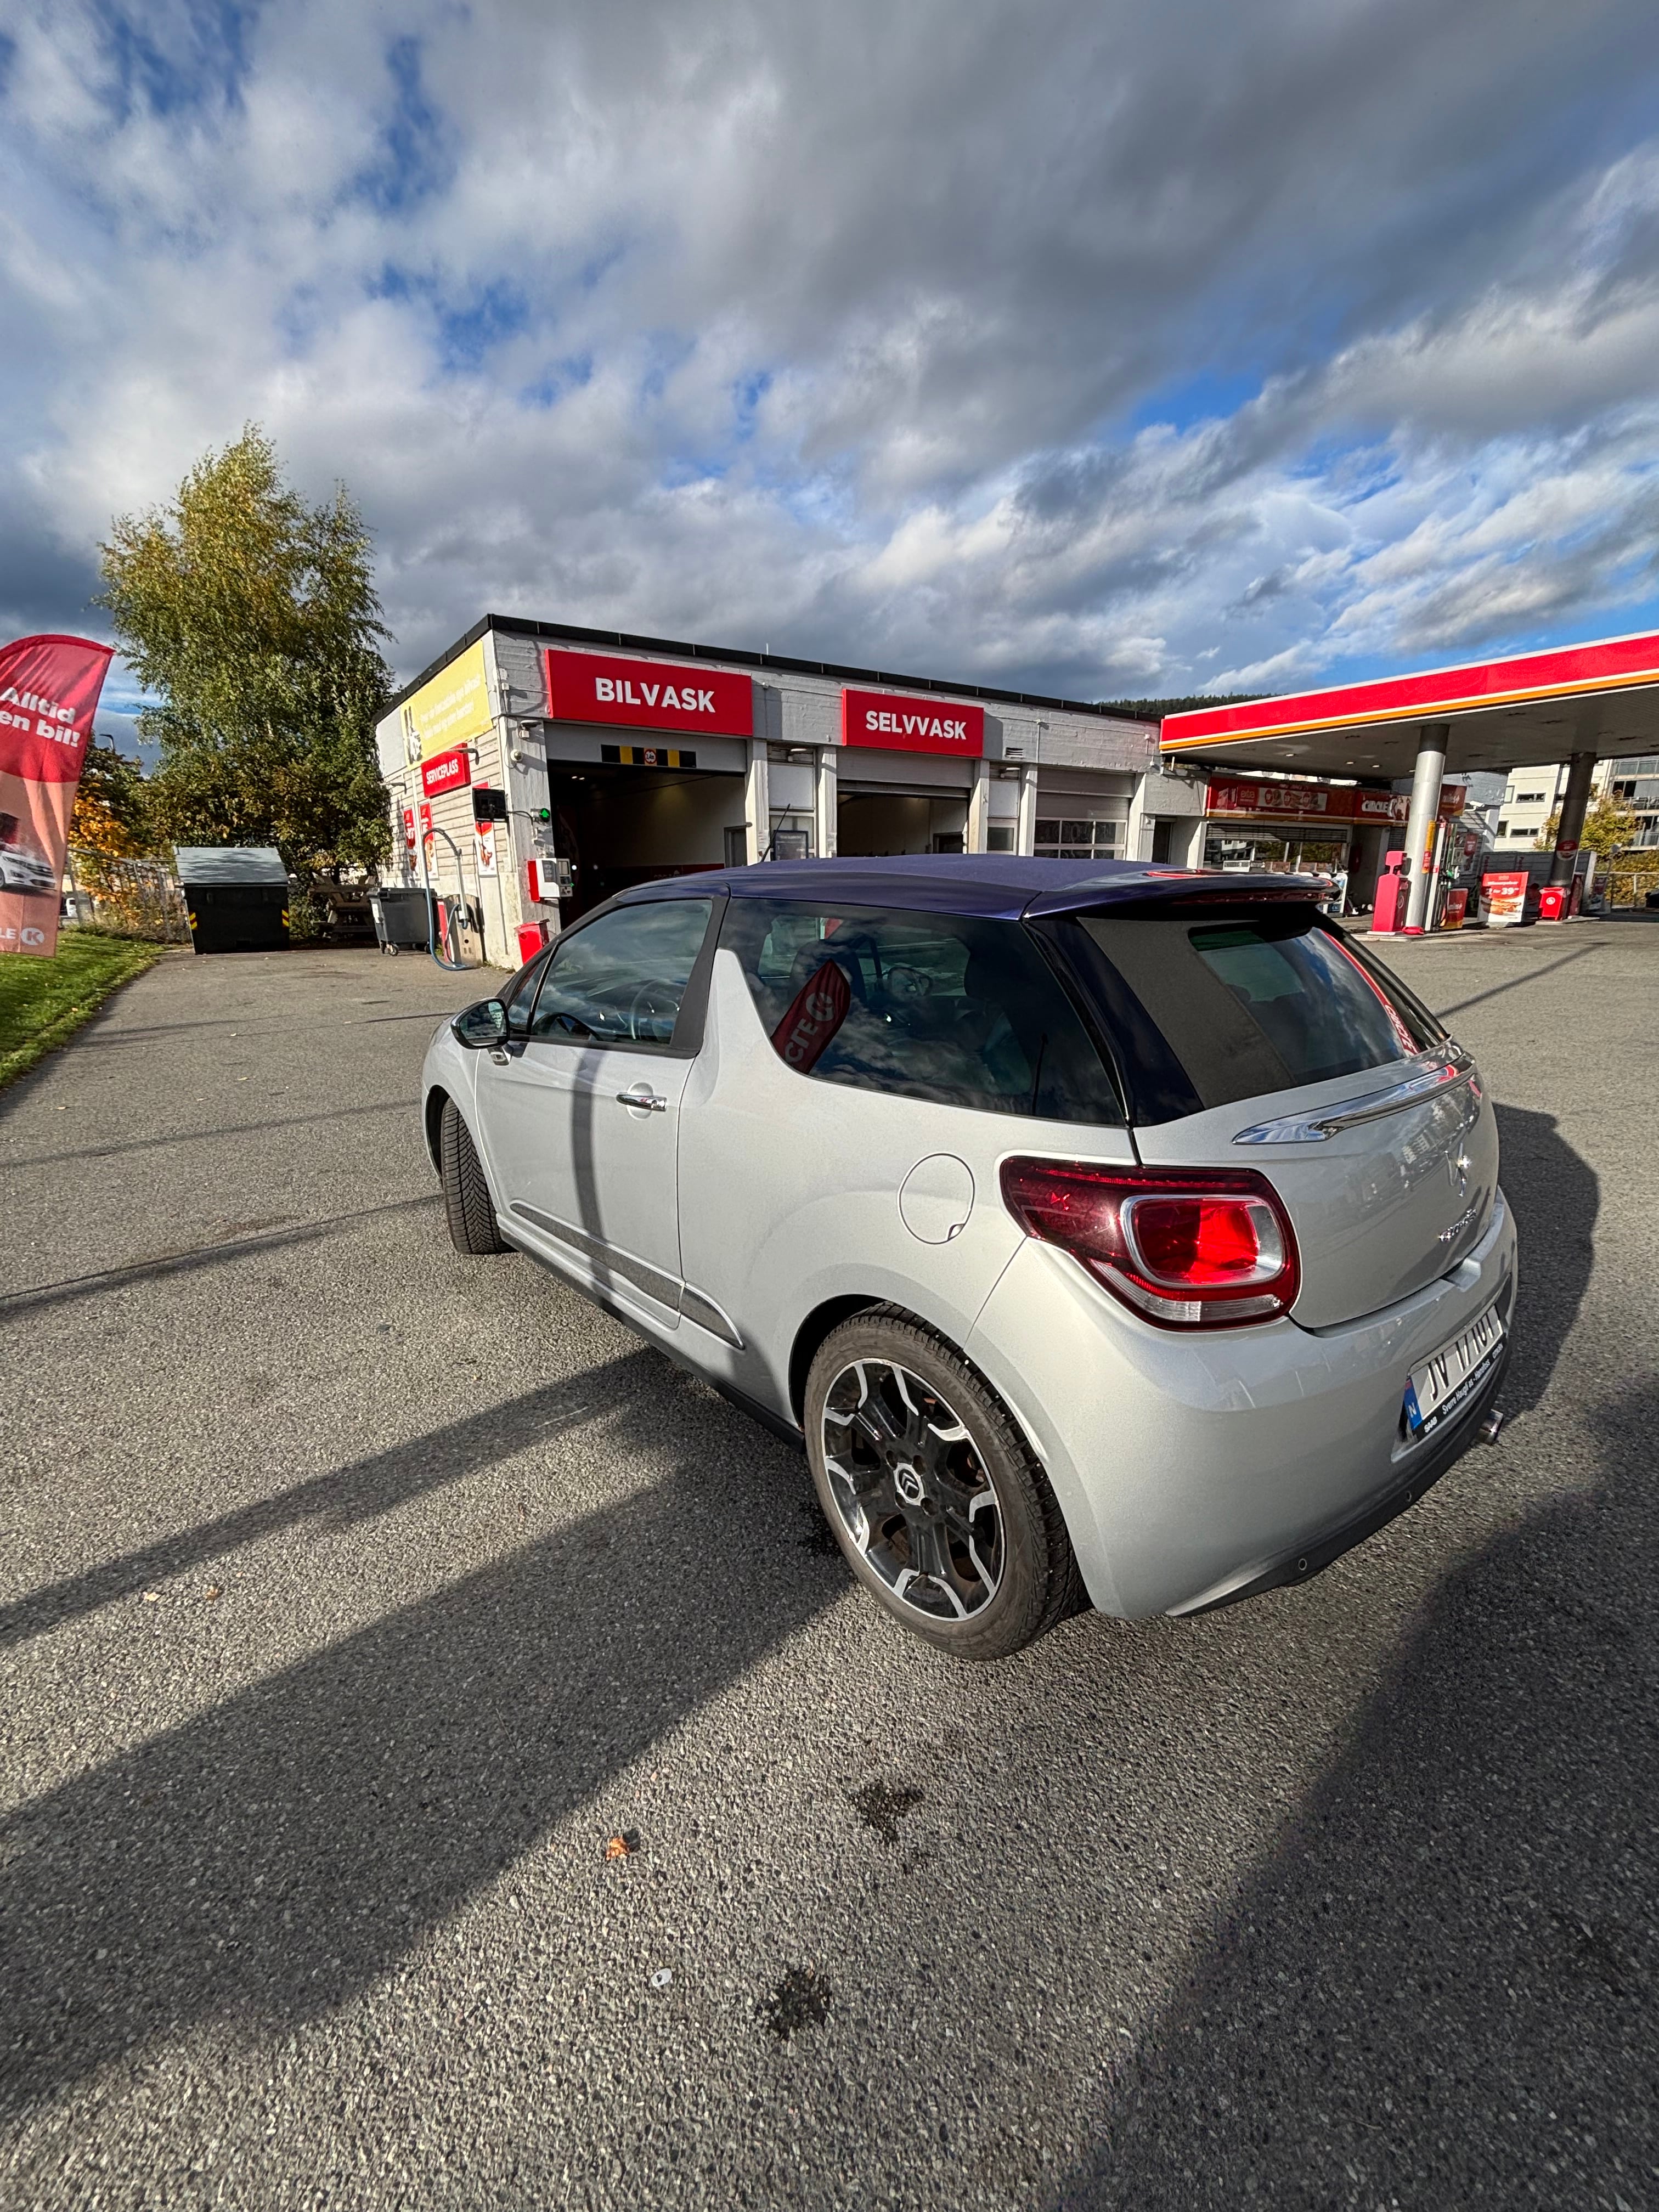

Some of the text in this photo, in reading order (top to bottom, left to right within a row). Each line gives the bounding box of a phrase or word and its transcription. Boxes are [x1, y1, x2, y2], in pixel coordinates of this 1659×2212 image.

[0, 687, 76, 724] Alltid
[595, 677, 716, 713] BILVASK
[36, 719, 80, 747] bil!
[866, 710, 967, 740] SELVVASK
[426, 758, 459, 785] SERVICEPLASS
[1408, 1402, 1417, 1419] N
[1424, 1416, 1437, 1433] SAAB
